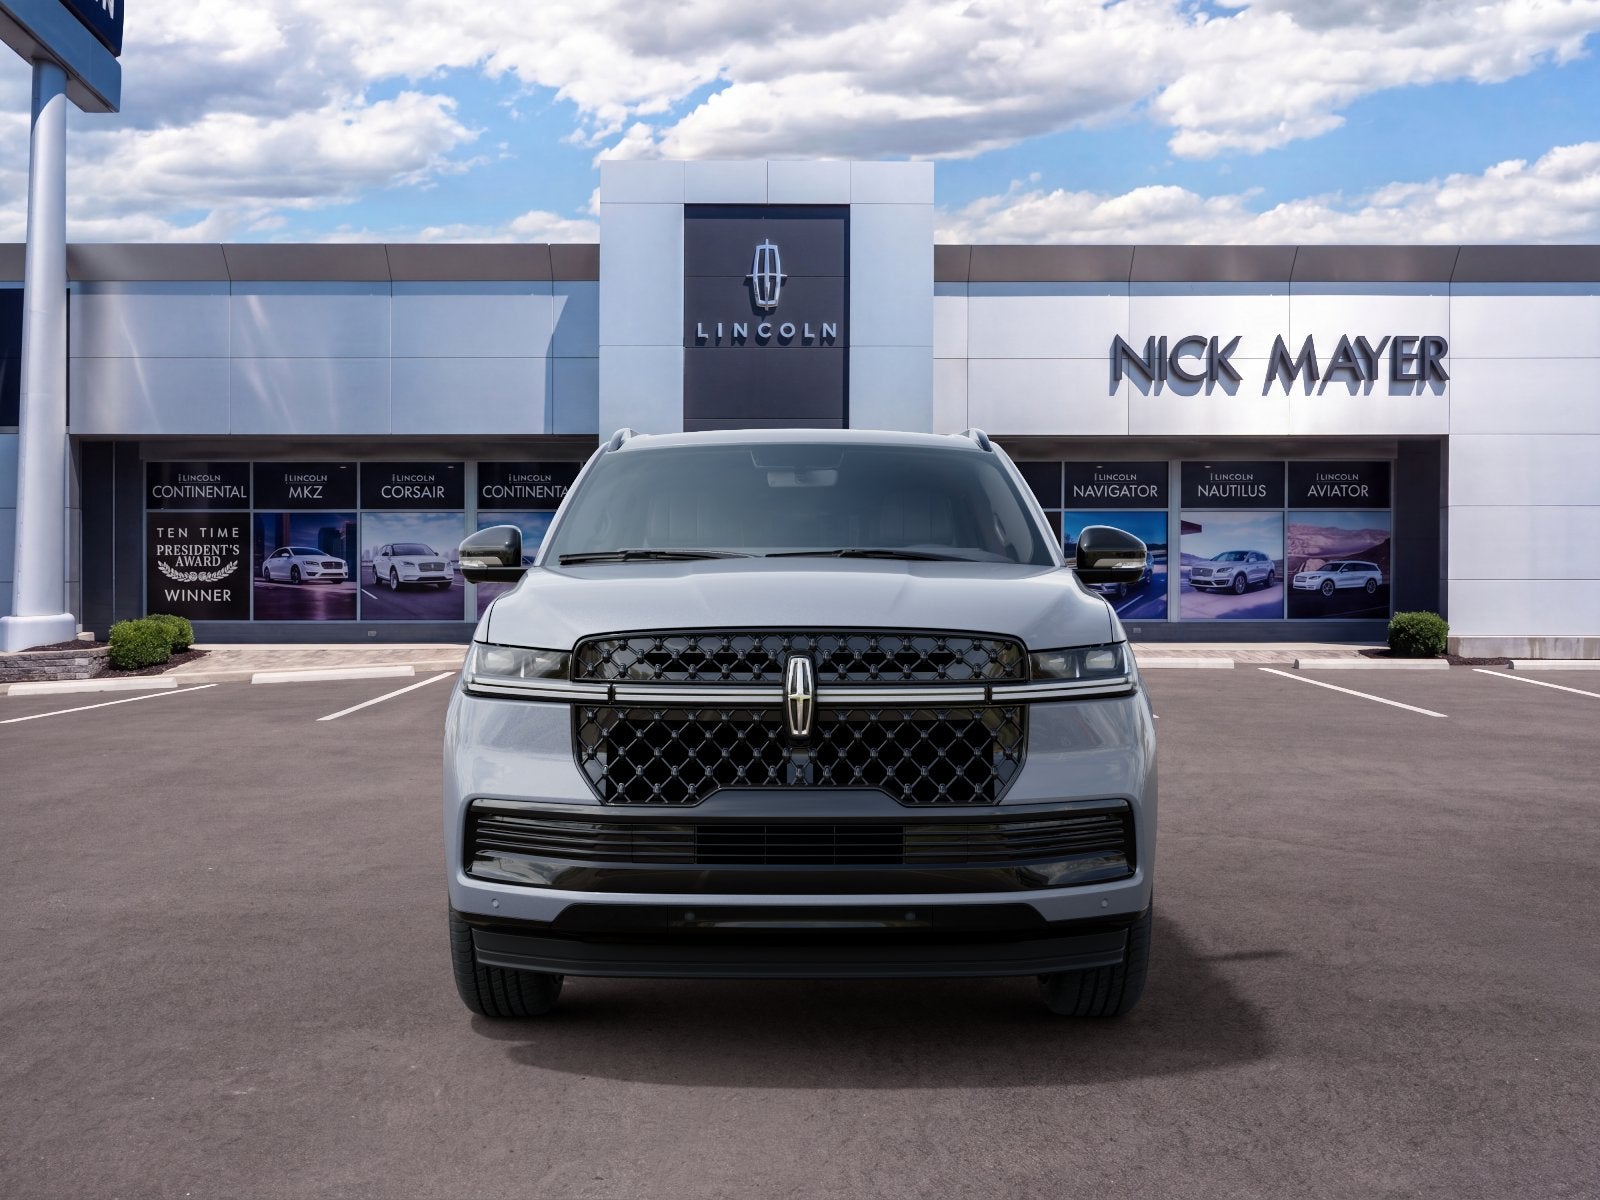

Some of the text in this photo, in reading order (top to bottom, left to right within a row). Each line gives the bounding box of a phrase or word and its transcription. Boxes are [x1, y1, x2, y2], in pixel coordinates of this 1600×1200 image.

[696, 322, 837, 338] LINCOLN
[1113, 333, 1450, 381] NICK MAYER
[182, 474, 221, 482] LINCOLN
[289, 474, 328, 482] LINCOLN
[396, 474, 435, 482] LINCOLN
[513, 474, 552, 482] LINCOLN
[1099, 473, 1137, 481] LINCOLN
[1215, 473, 1254, 481] LINCOLN
[1321, 473, 1359, 481] LINCOLN
[152, 485, 247, 498] CONTINENTAL
[288, 486, 323, 499] MKZ
[381, 485, 445, 498] CORSAIR
[482, 485, 568, 498] CONTINENTA
[1073, 484, 1158, 498] NAVIGATOR
[1197, 484, 1267, 497] NAUTILUS
[1307, 484, 1369, 497] AVIATOR
[157, 527, 240, 538] TEN TIME
[156, 544, 240, 556] PRESIDENT'S
[175, 555, 221, 567] AWARD
[165, 589, 232, 602] WINNER
